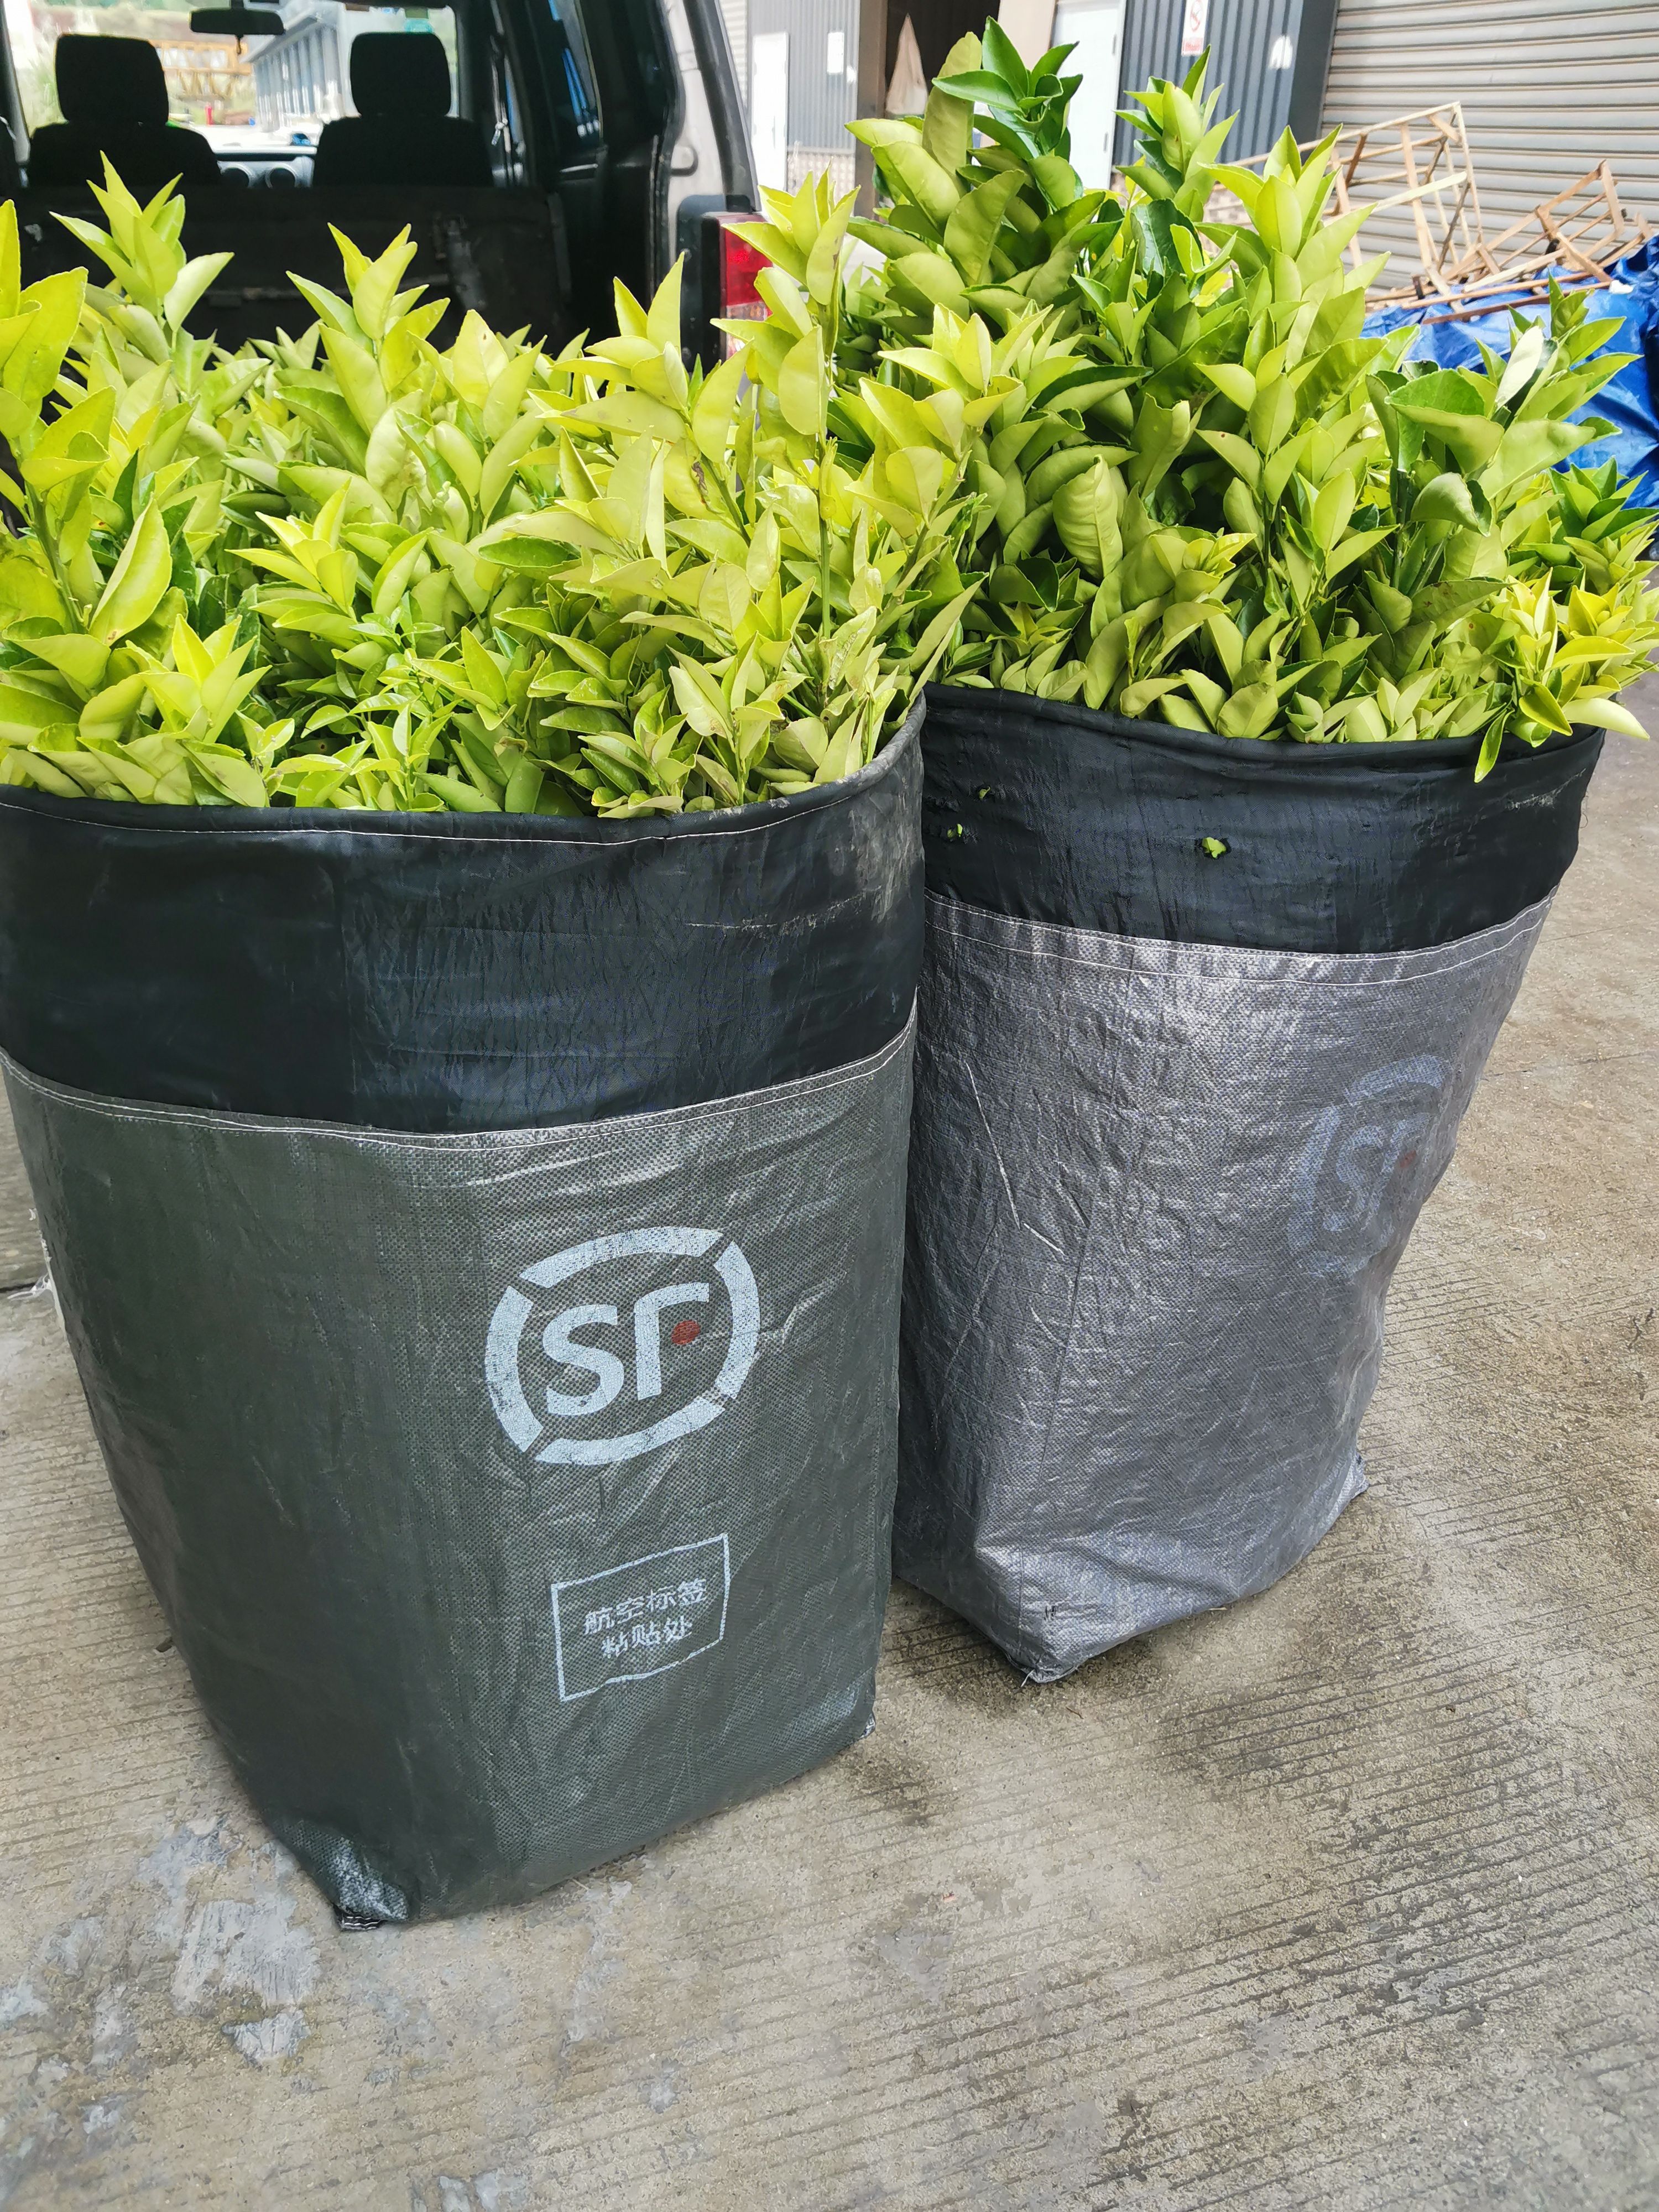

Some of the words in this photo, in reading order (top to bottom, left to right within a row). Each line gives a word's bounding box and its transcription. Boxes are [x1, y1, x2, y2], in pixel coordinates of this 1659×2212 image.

[542, 1282, 710, 1416] SF
[583, 1578, 707, 1635] 航空标签
[601, 1615, 693, 1658] 粘贴处
